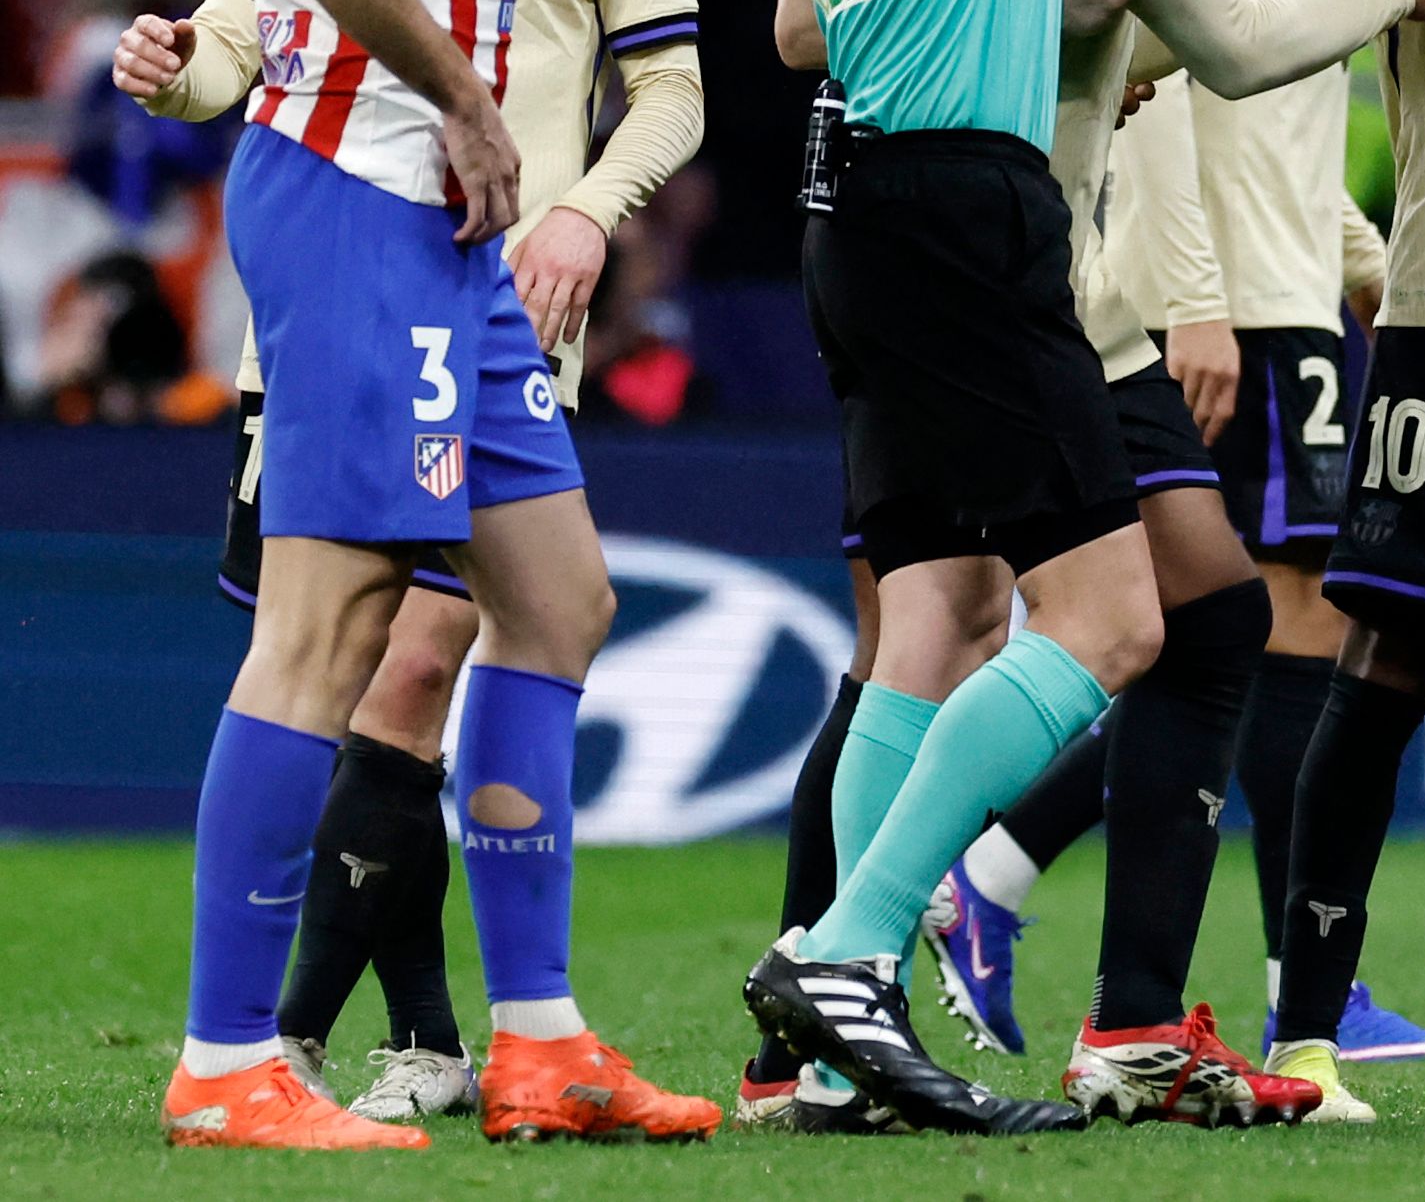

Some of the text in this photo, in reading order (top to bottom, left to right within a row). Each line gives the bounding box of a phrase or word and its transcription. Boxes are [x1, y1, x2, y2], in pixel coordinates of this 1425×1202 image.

[410, 326, 459, 423] 3
[1299, 356, 1345, 446] 2
[465, 831, 555, 854] ATLETI
